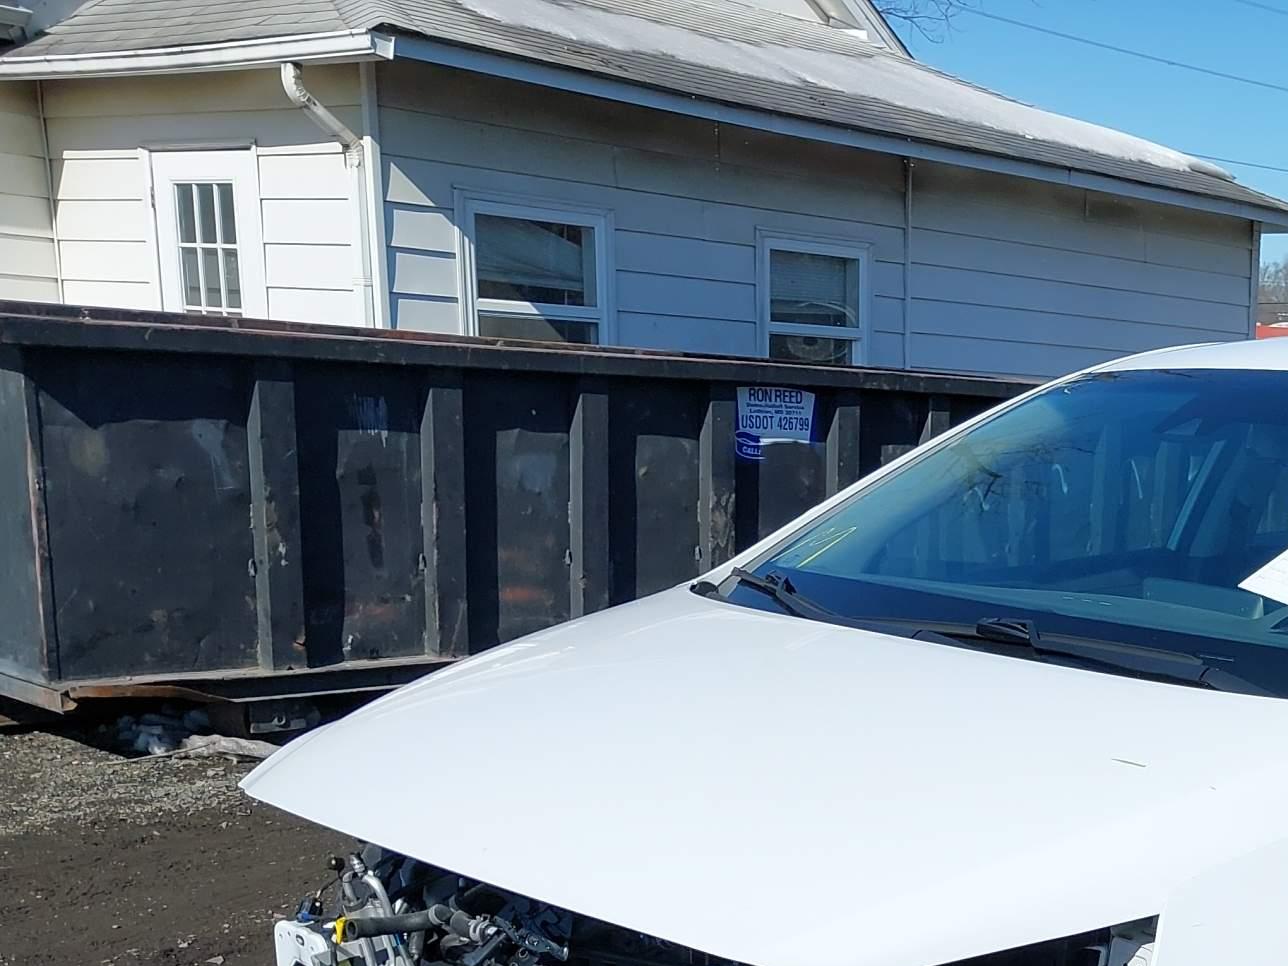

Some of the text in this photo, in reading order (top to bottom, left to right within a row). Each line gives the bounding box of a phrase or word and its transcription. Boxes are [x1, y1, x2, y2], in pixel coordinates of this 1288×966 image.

[749, 388, 803, 404] RON REED
[742, 415, 809, 431] USDOT 426799
